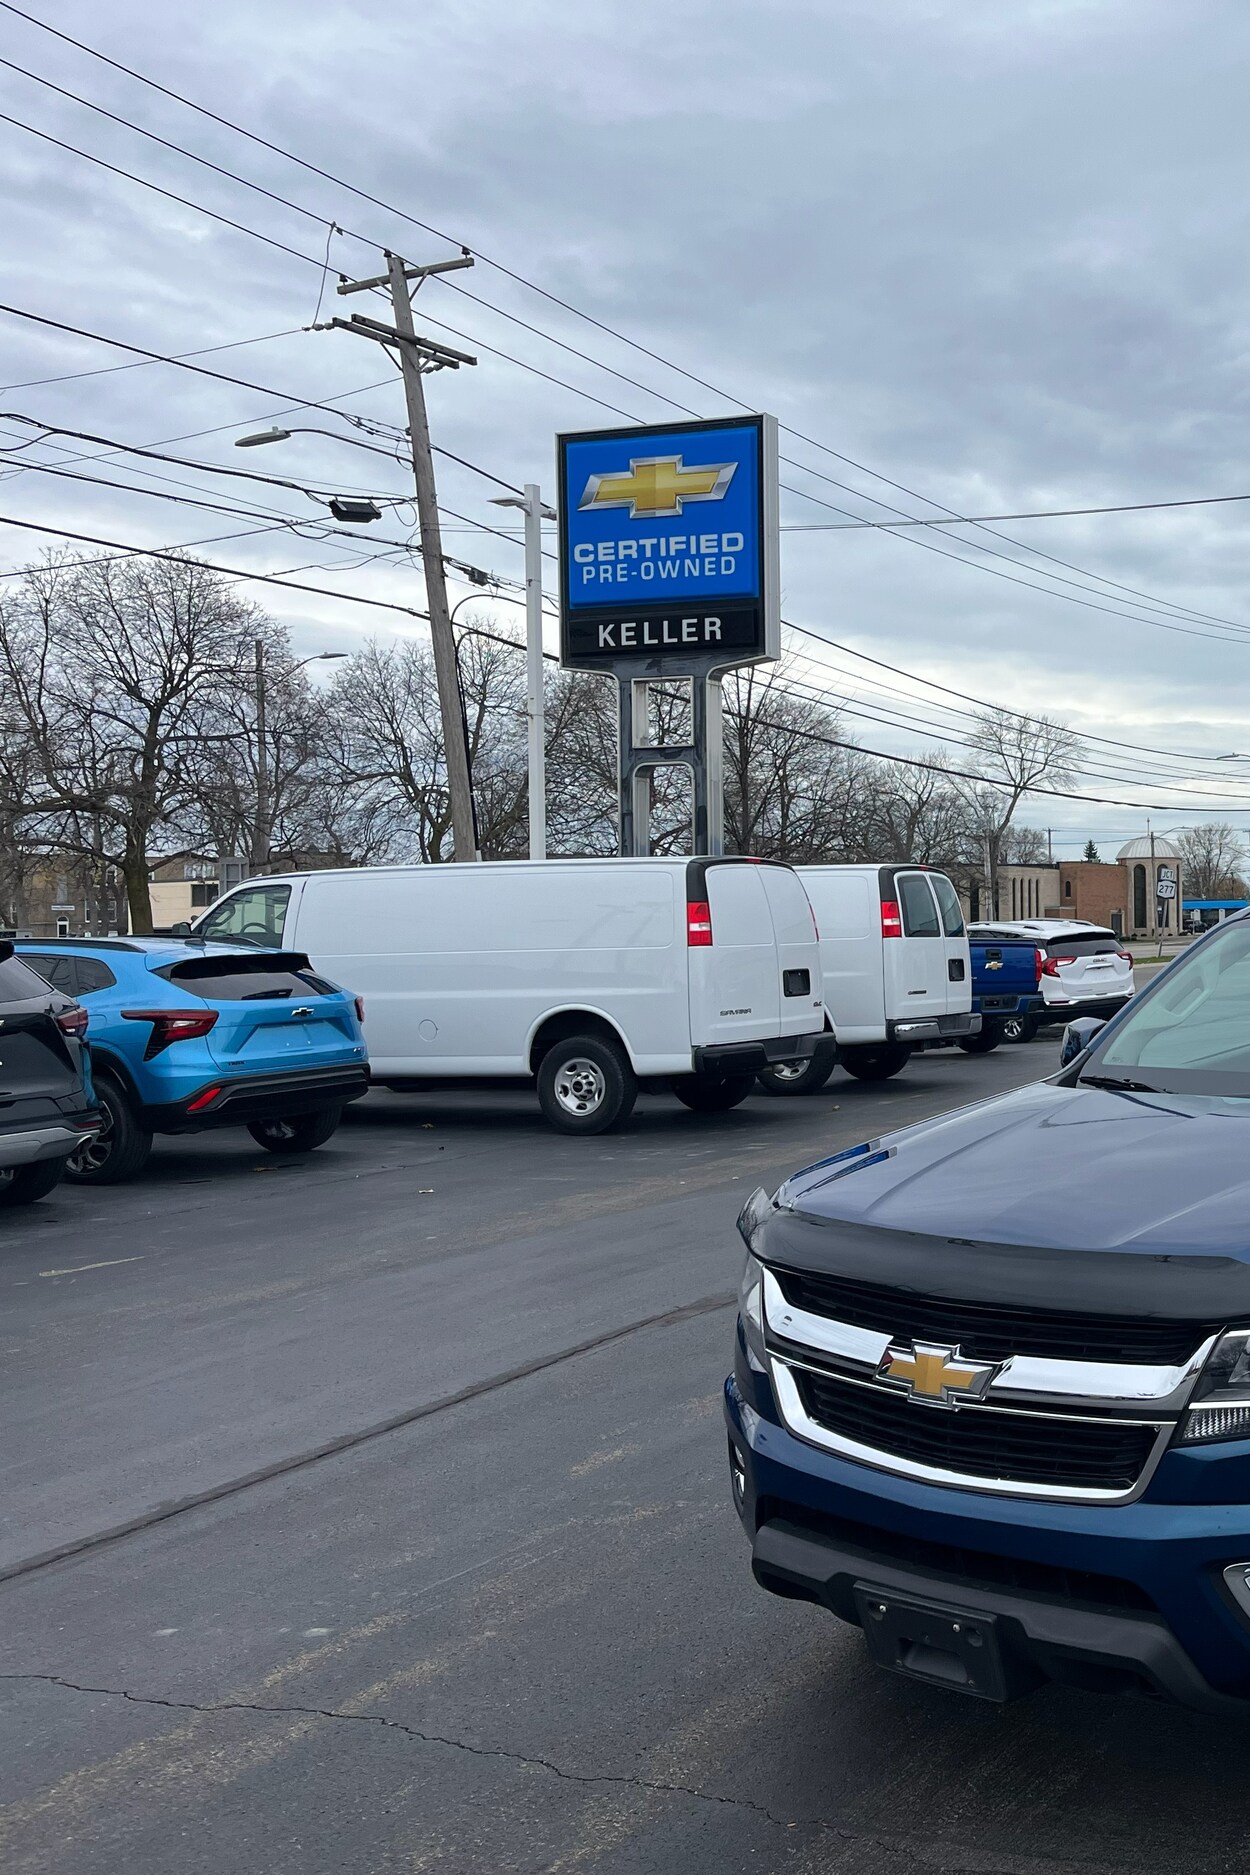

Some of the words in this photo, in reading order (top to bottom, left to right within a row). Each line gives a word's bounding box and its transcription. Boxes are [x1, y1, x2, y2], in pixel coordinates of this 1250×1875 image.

[573, 532, 744, 563] CERTIFIED
[583, 556, 736, 584] PRE-OWNED
[598, 617, 722, 648] KELLER
[1162, 870, 1173, 879] JCT
[1159, 884, 1174, 894] 277
